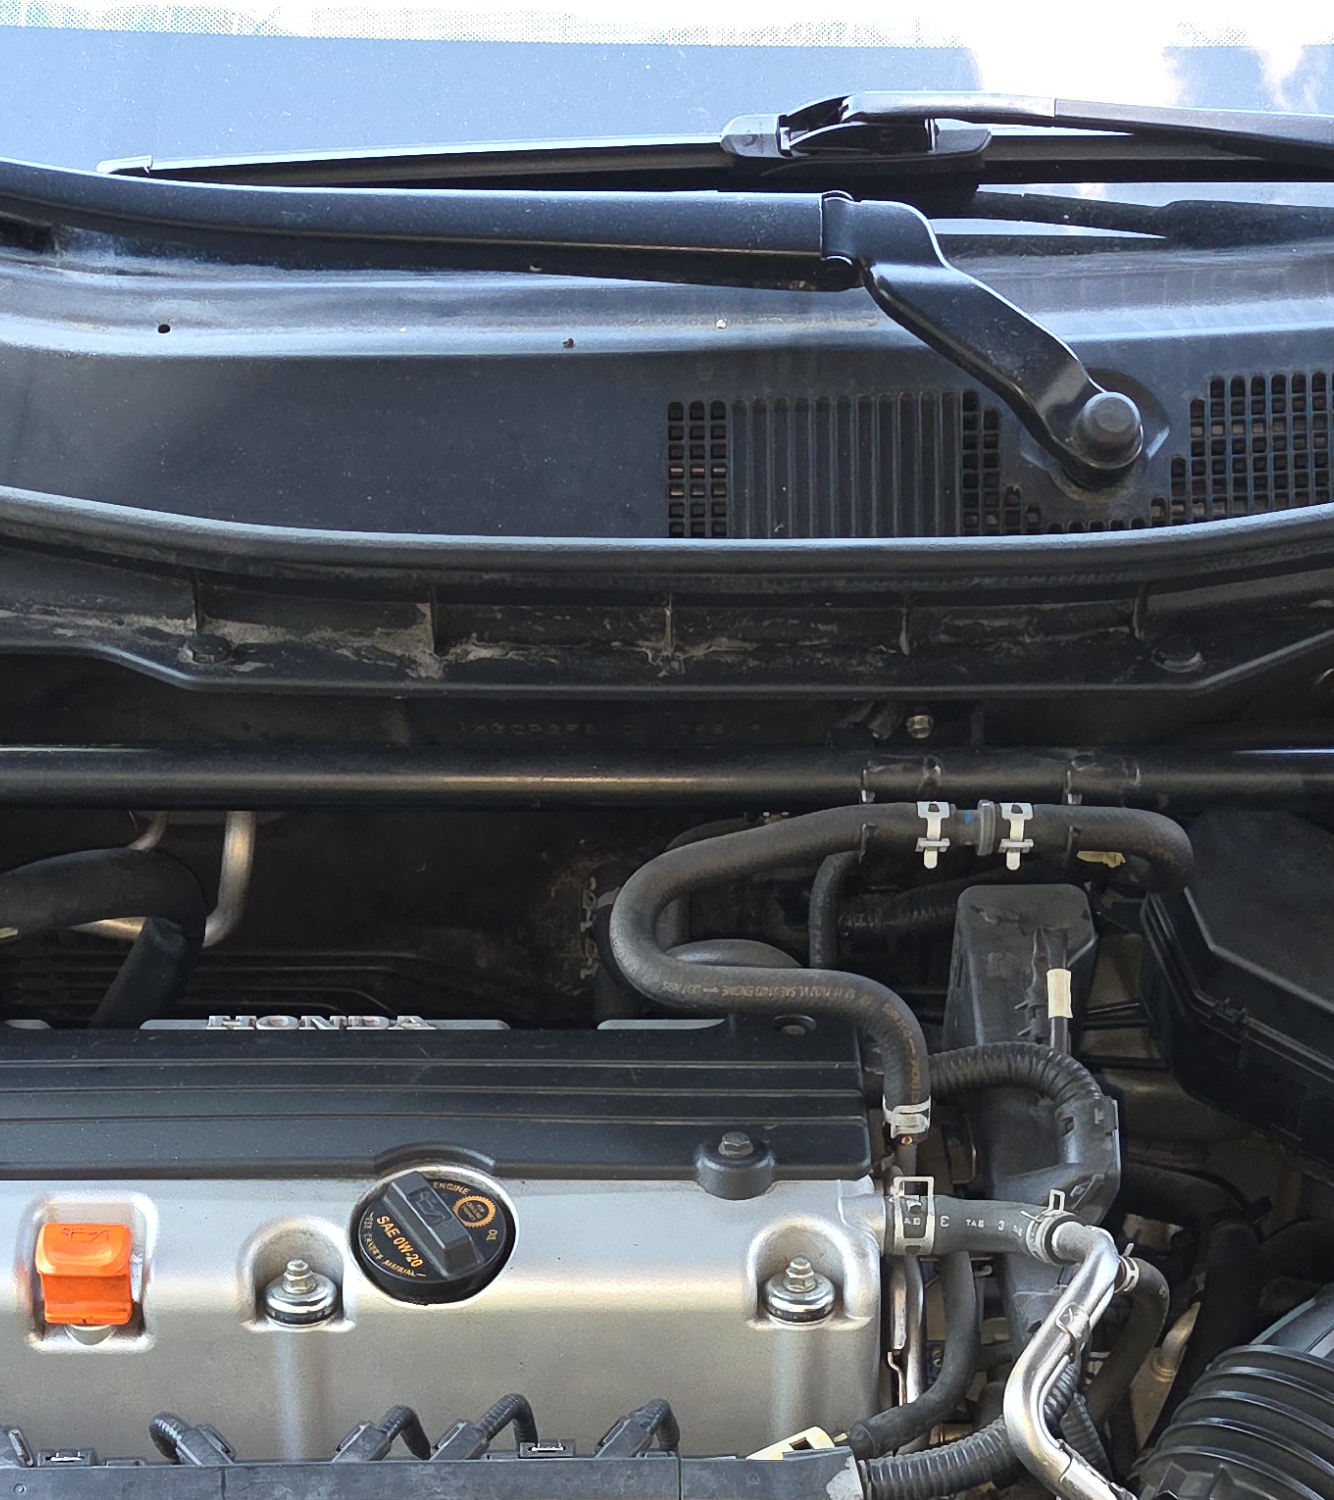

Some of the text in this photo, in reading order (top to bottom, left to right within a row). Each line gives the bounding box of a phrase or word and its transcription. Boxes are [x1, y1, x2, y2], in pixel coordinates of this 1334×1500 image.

[205, 1015, 438, 1031] HONDA
[433, 1181, 472, 1195] ENGINE
[376, 1215, 423, 1267] SAE 0W-20
[486, 1229, 498, 1242] OIL
